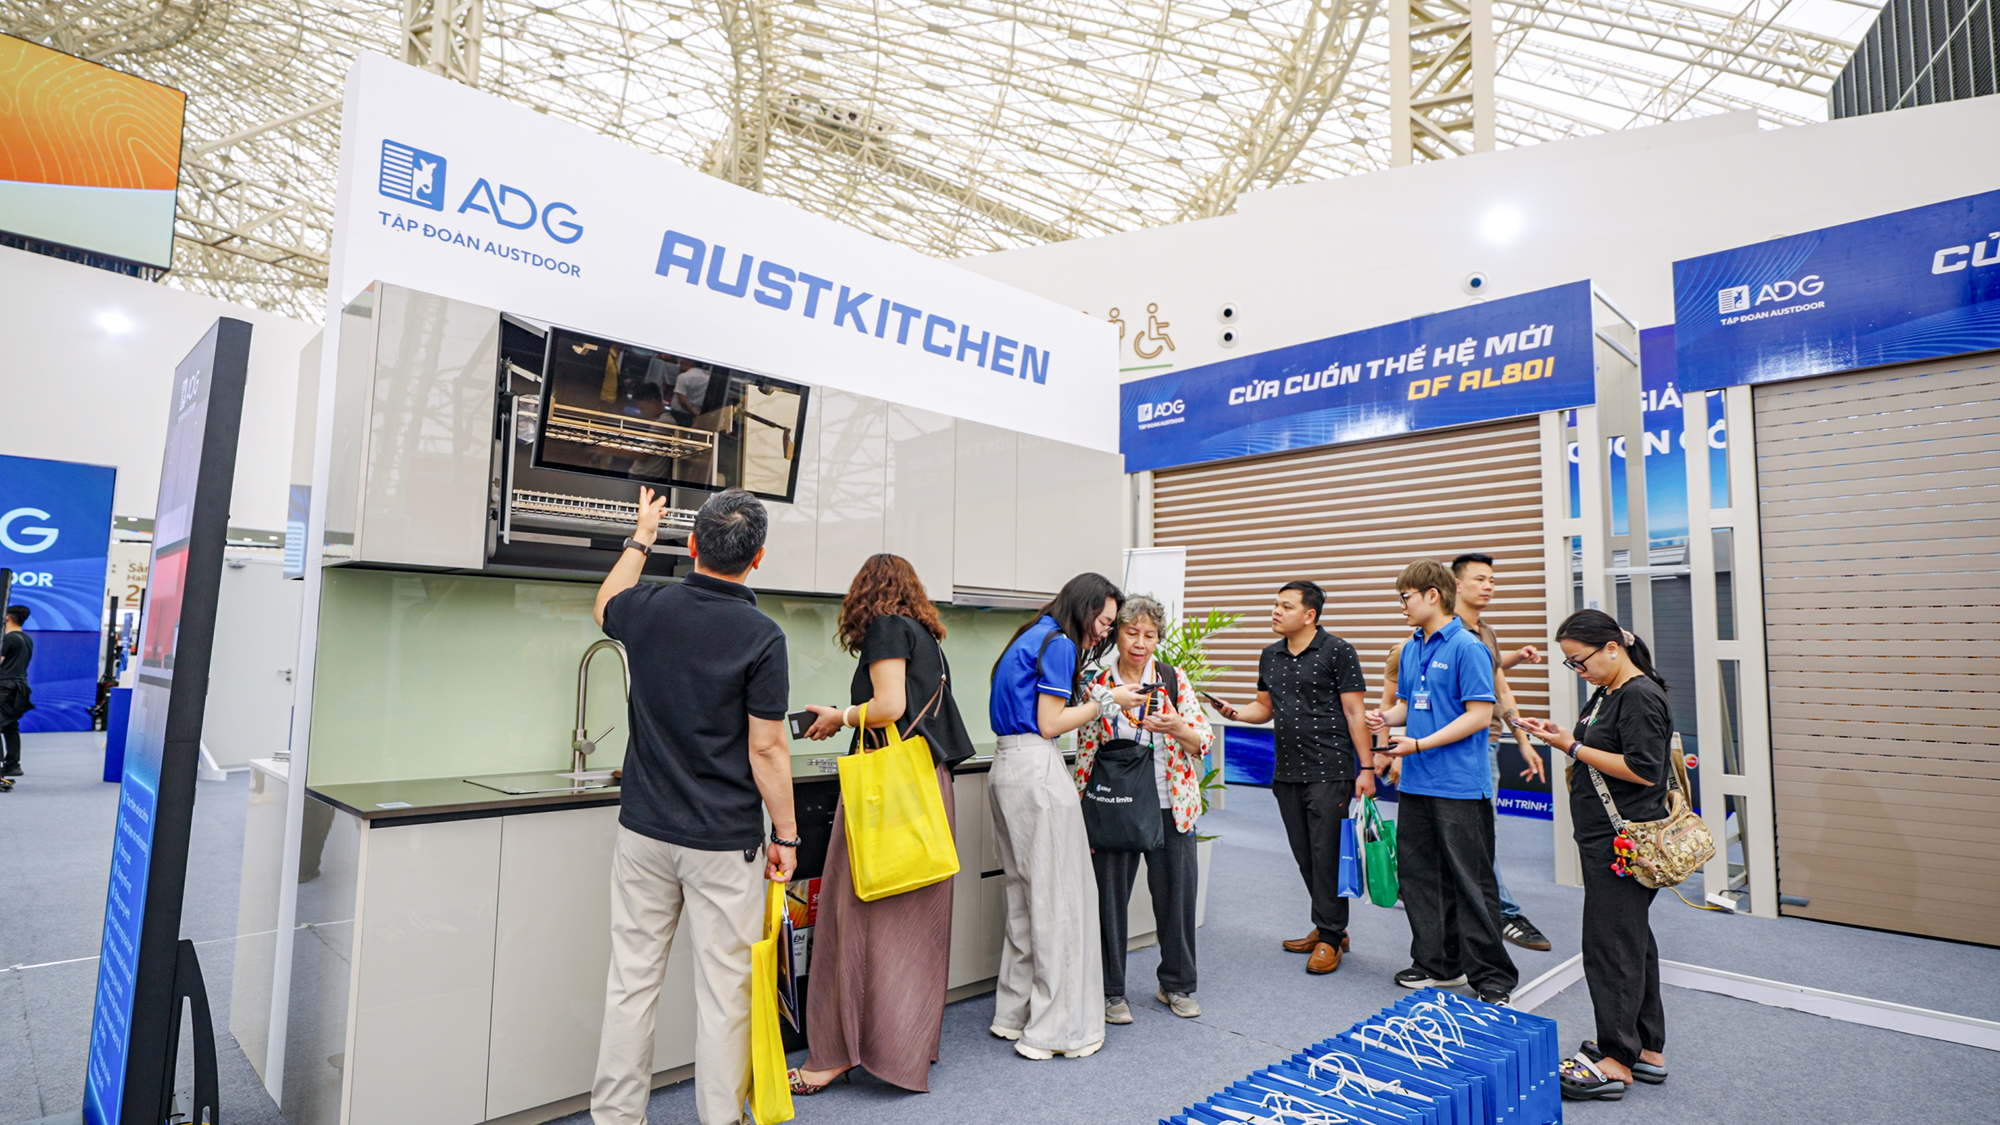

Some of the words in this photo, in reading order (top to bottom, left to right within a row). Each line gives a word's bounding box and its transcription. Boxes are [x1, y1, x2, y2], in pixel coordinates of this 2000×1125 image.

[457, 177, 584, 244] ADG
[378, 211, 419, 232] TẬP
[422, 223, 480, 250] ĐOÀN
[484, 241, 581, 278] AUSTDOOR
[1755, 274, 1825, 306] ADG
[655, 229, 1051, 386] AUSTKITCHEN
[1721, 315, 1739, 326] TẬP
[1740, 310, 1769, 323] ĐOÀN
[1770, 300, 1825, 317] AUSTDOOR
[1228, 379, 1281, 405] CỬA
[1284, 362, 1361, 396] CUỐN
[1366, 344, 1426, 379] THẾ
[1432, 337, 1477, 367] HỆ
[1484, 323, 1554, 358] MỚI
[1407, 375, 1452, 401] DF
[1154, 399, 1185, 419] ADG
[125, 584, 140, 602] 2
